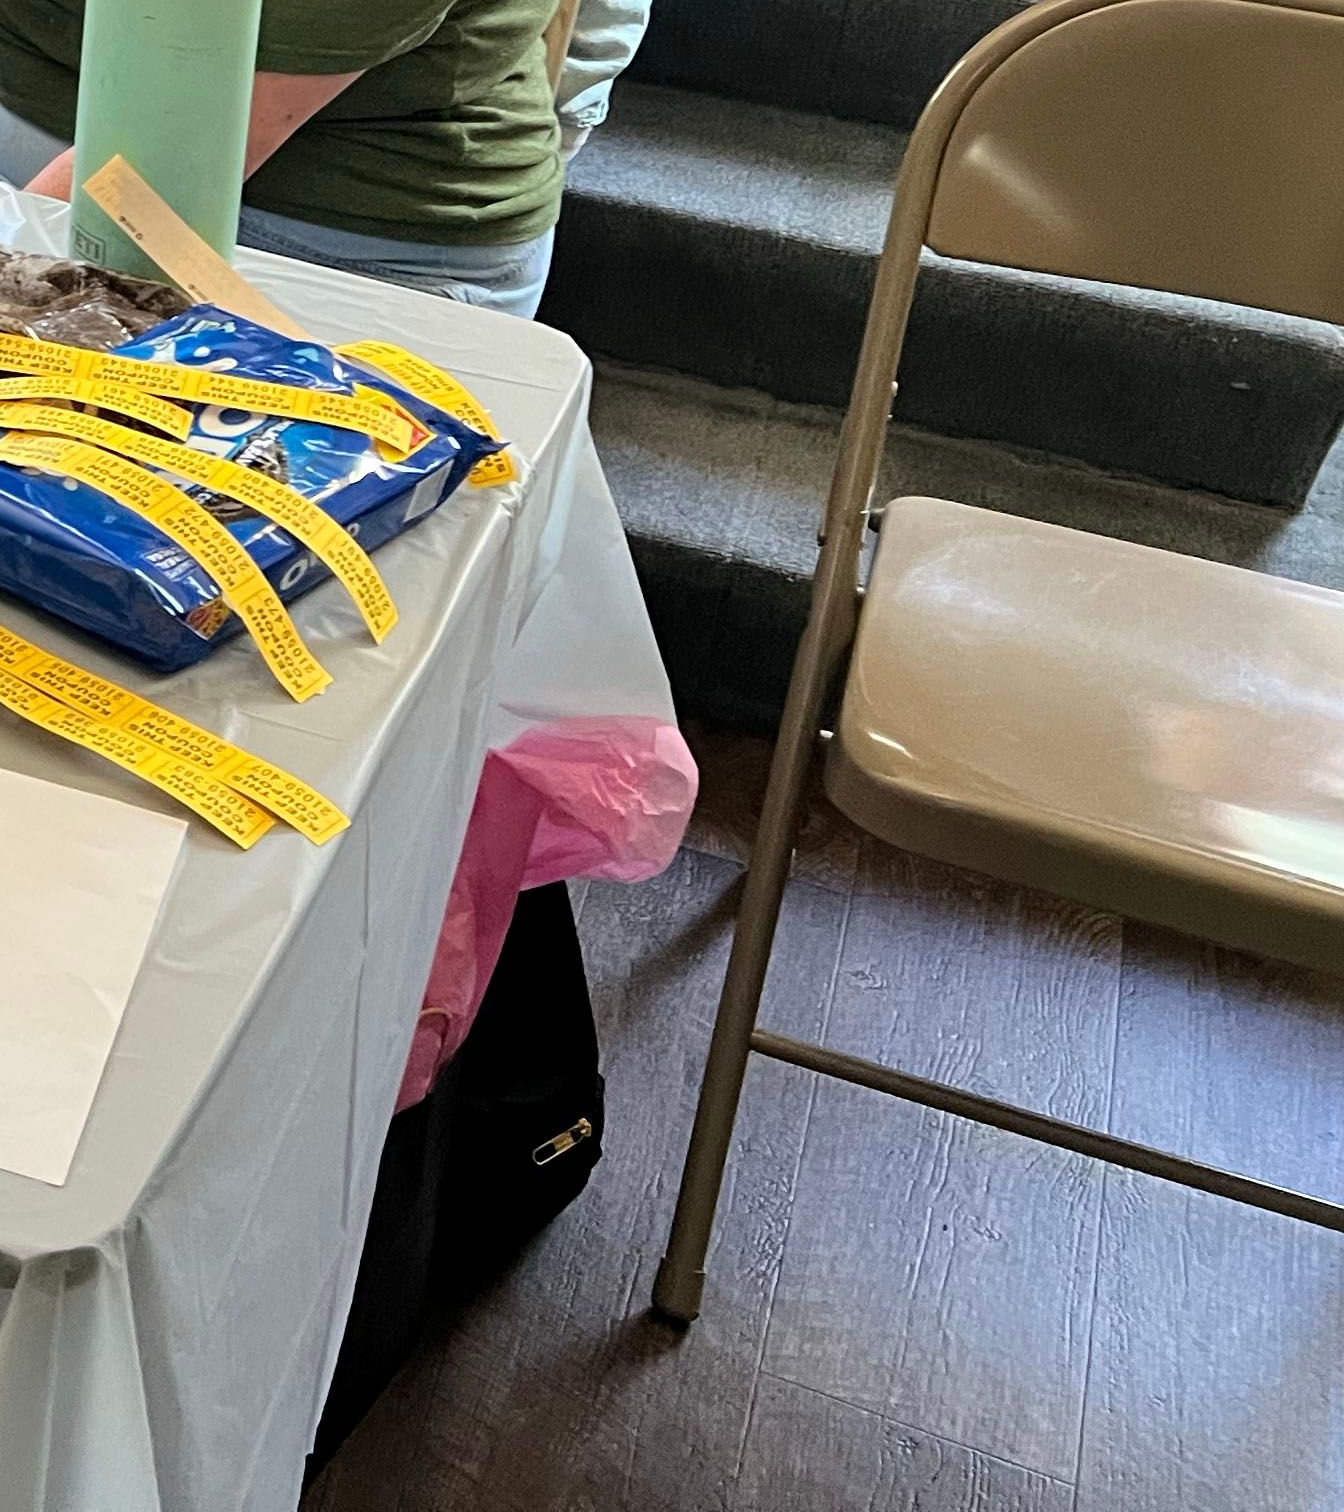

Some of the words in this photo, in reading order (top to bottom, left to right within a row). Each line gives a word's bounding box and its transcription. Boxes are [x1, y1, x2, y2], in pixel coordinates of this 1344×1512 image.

[29, 362, 72, 374] KEEP
[102, 368, 173, 385] COUPON
[136, 380, 180, 392] KEEP
[210, 386, 283, 403] COUPON
[244, 397, 291, 410] KEEP
[88, 465, 150, 498] COUPON
[110, 485, 150, 508] KEEP
[241, 483, 309, 525] COUPON
[270, 507, 311, 536] KEEP
[178, 518, 237, 575] COUPON
[200, 550, 235, 587] KEEP
[257, 609, 302, 678] COUPON
[270, 649, 303, 689] KEEP
[44, 671, 111, 706] COUPON
[69, 694, 111, 716] KEEP
[62, 721, 135, 756] COUPON
[92, 741, 136, 764] KEEP
[143, 722, 214, 758] COUPON
[169, 746, 214, 768] KEEP
[170, 775, 243, 823] COUPON
[247, 775, 319, 821] COUPON
[200, 803, 245, 836] KEEP
[274, 801, 319, 832] KEEP
